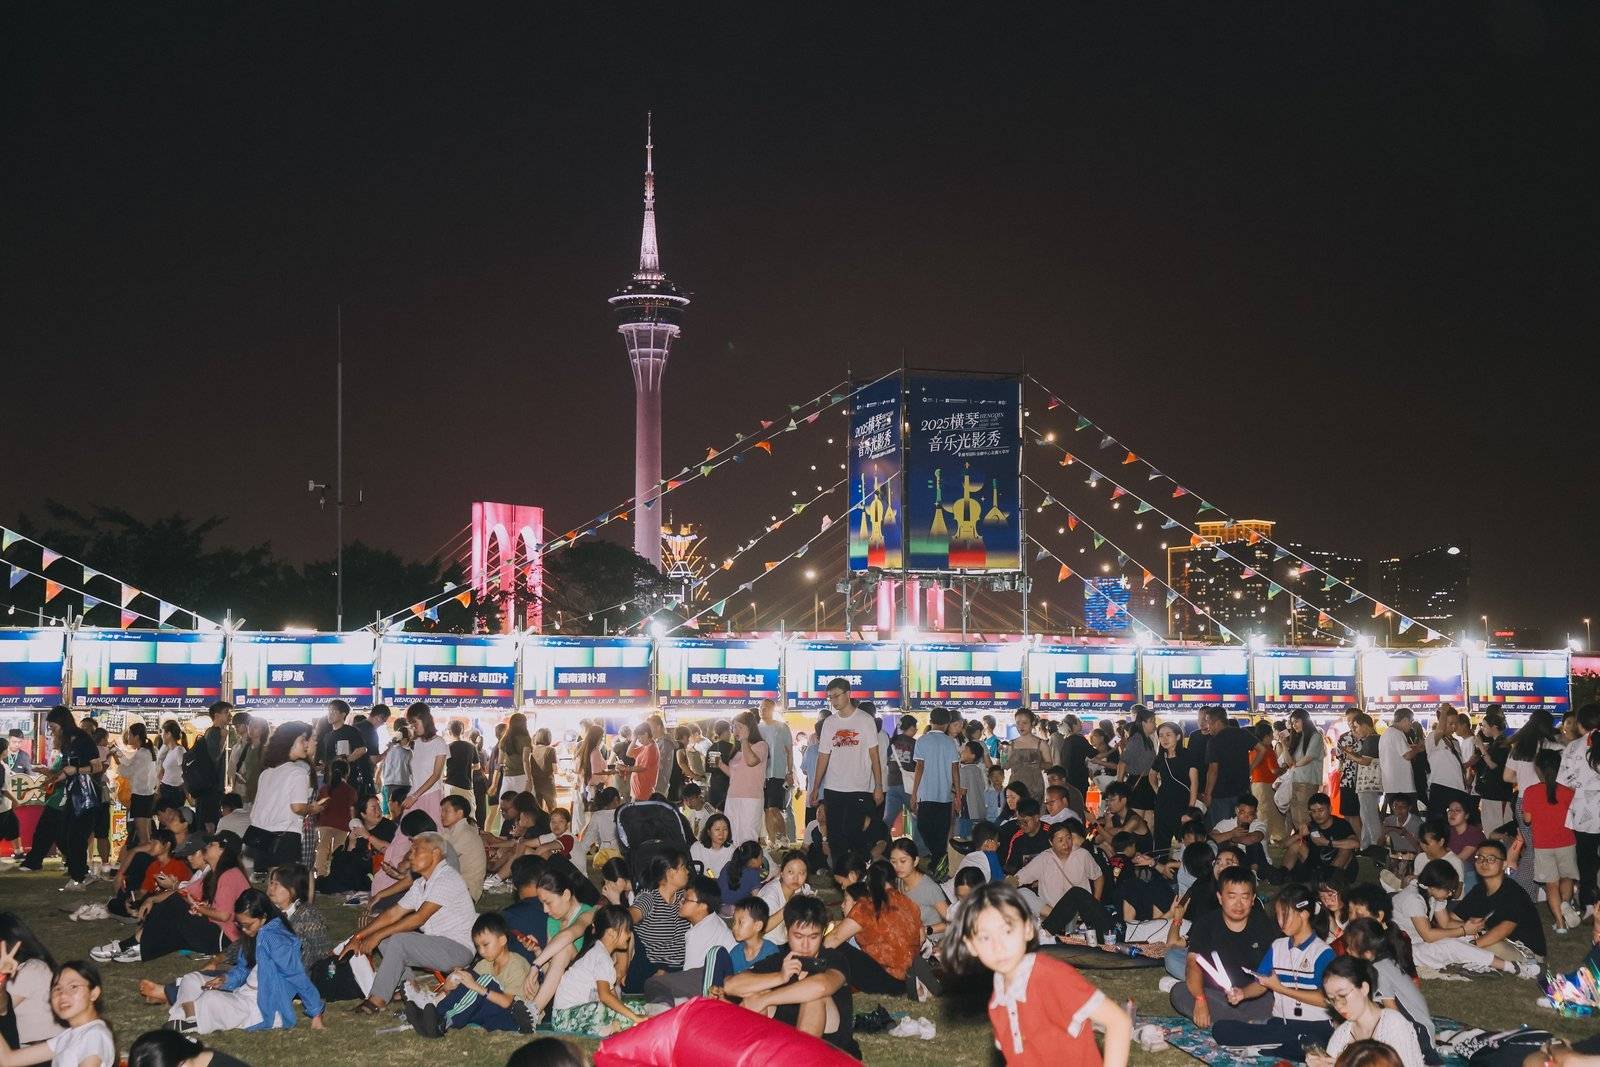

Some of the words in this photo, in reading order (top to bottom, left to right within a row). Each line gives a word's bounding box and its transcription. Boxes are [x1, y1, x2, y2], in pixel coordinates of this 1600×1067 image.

[921, 412, 980, 431] 2025横琴
[928, 430, 1001, 456] 音乐光影秀
[1172, 679, 1213, 689] 山茶花之丘
